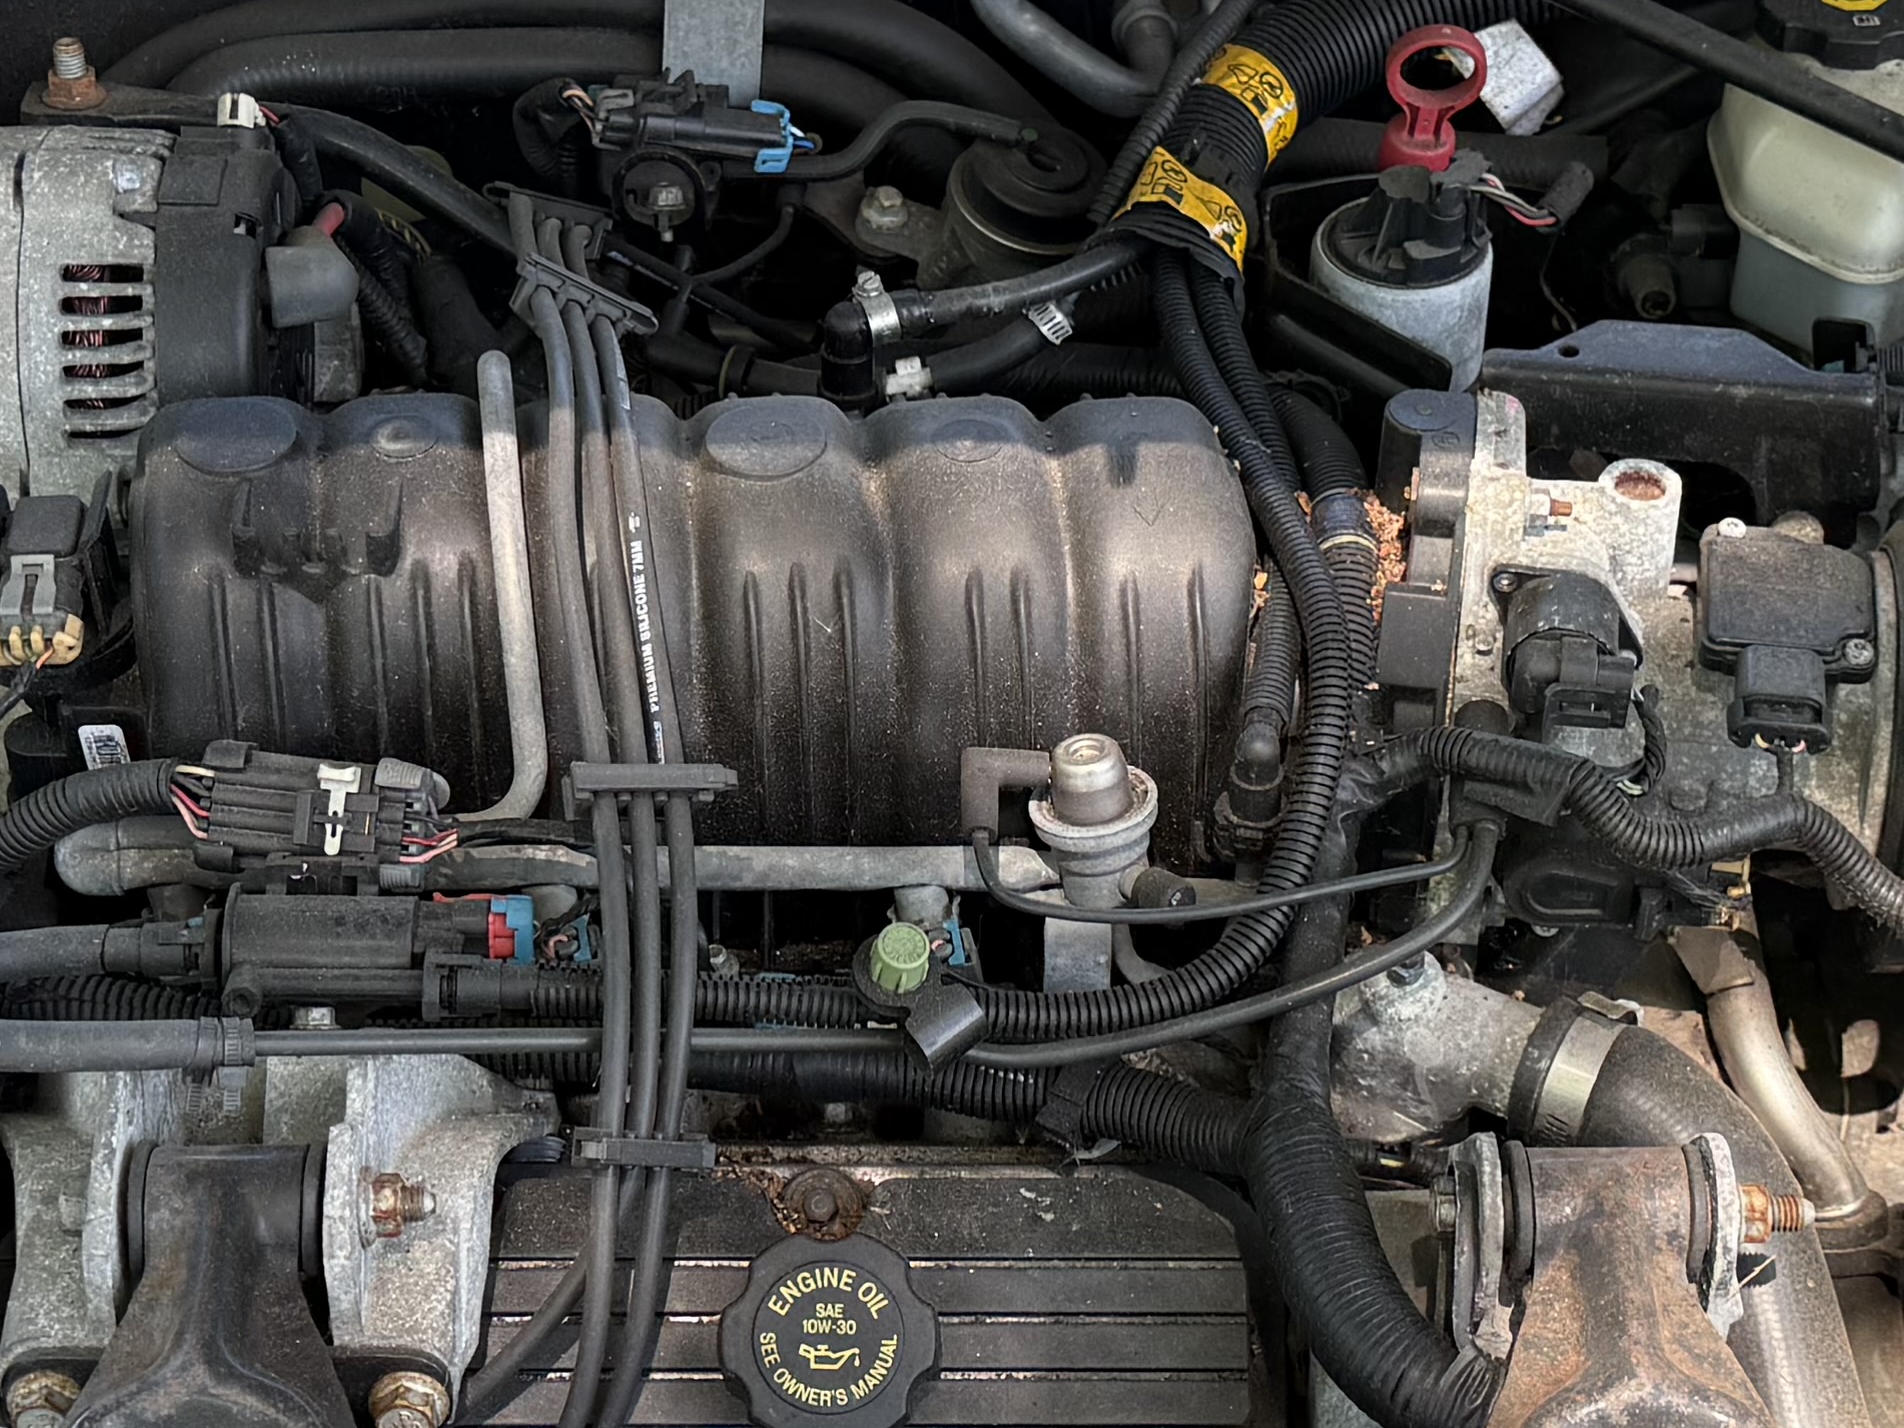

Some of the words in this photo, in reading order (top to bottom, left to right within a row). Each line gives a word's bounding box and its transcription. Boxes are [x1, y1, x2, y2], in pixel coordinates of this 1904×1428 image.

[629, 539, 645, 574] 7MM
[632, 573, 652, 642] SILICONE
[641, 642, 660, 714] PREMIUM
[767, 1267, 858, 1317] ENGINE
[857, 1281, 889, 1320] OIL
[815, 1303, 844, 1319] SAE
[802, 1319, 858, 1335] 10W-30
[759, 1331, 781, 1369] SEE
[772, 1367, 849, 1408] OWNER'S
[850, 1333, 898, 1401] MANUAL
